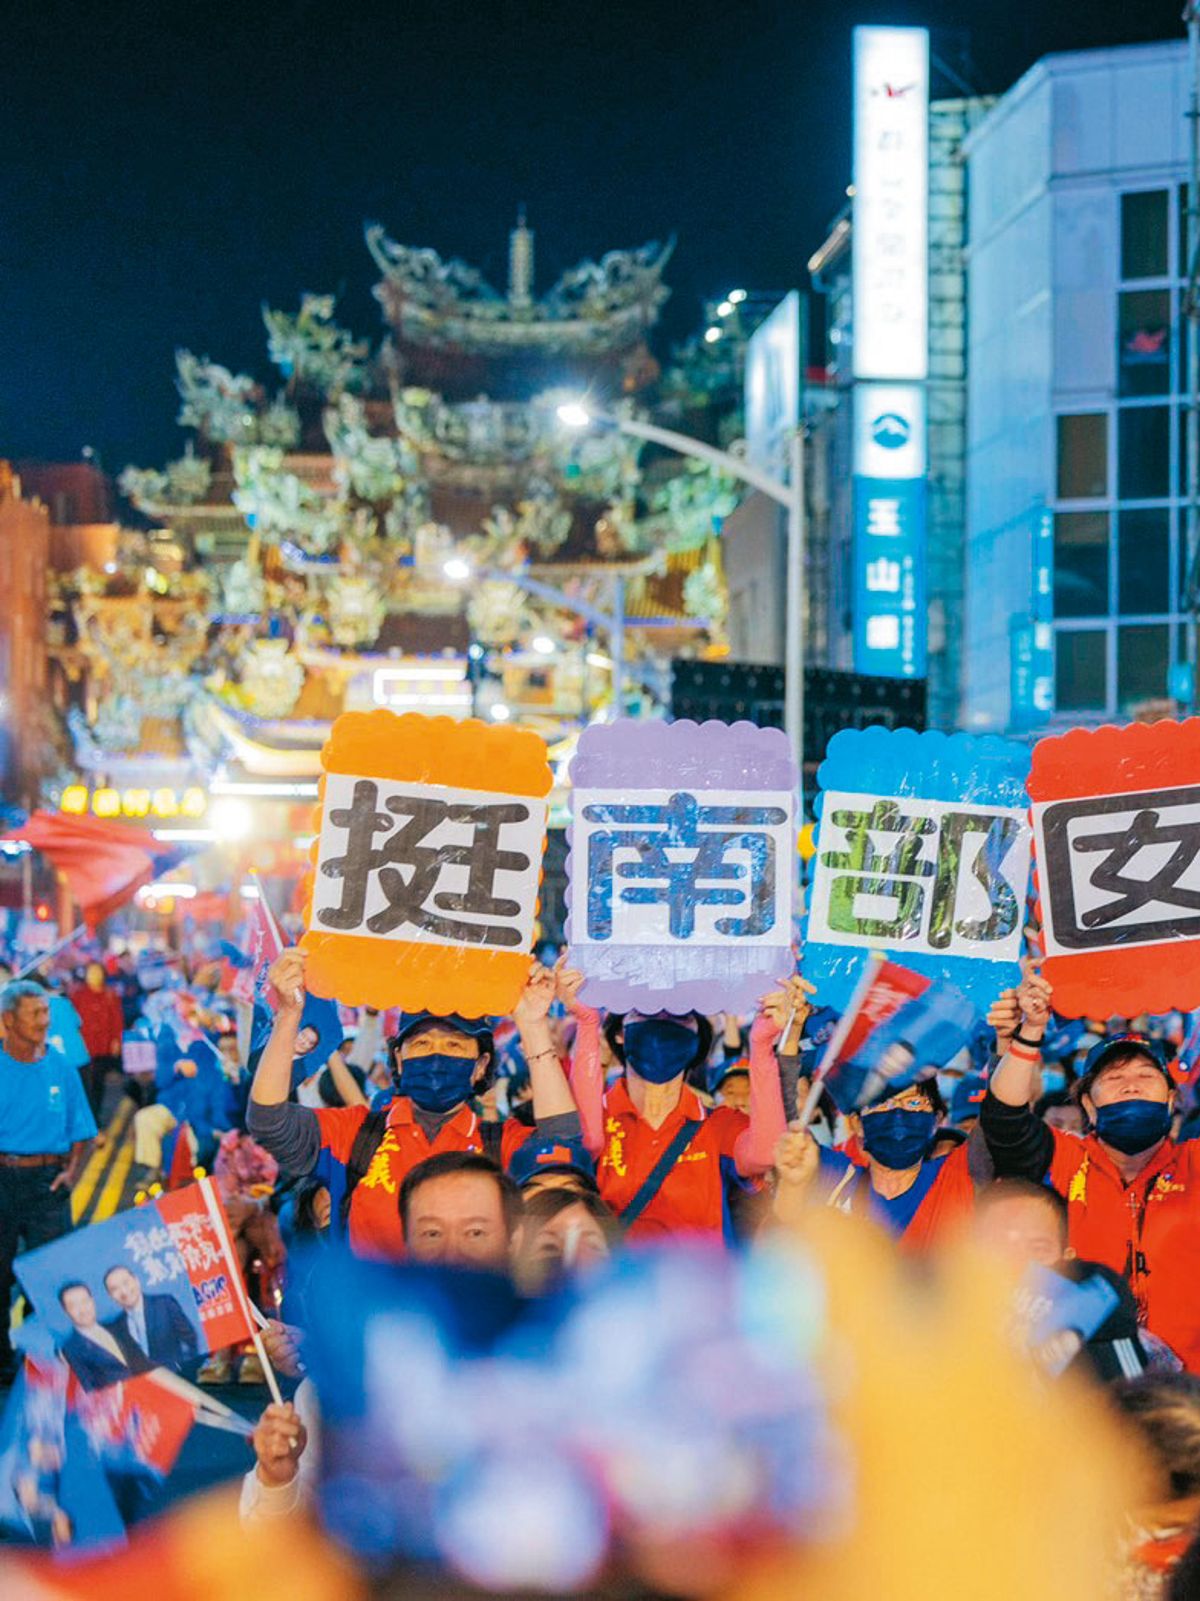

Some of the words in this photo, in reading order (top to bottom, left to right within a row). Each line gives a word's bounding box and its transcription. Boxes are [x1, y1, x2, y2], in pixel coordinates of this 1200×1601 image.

[317, 779, 531, 947] 挺
[581, 792, 788, 940] 南
[820, 799, 1020, 949] 部
